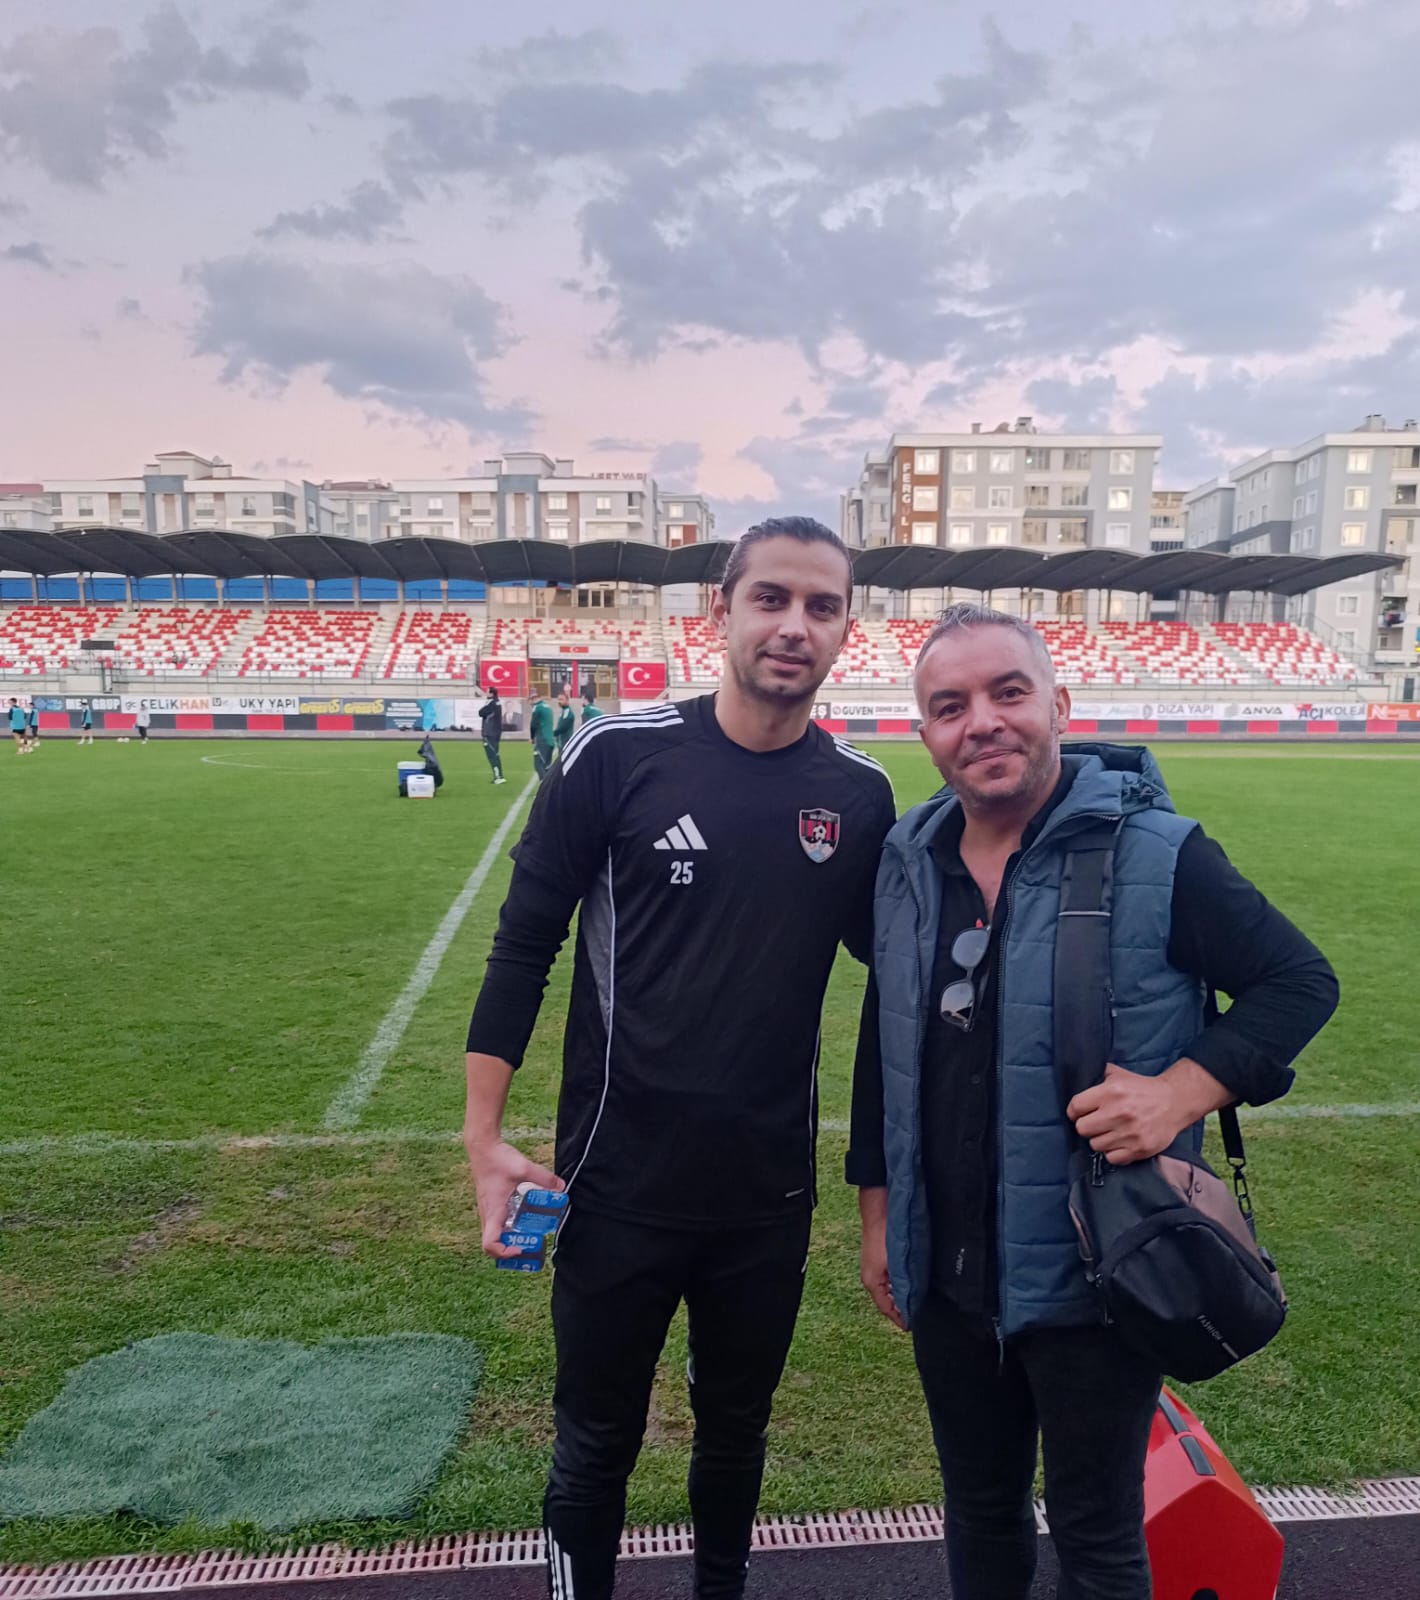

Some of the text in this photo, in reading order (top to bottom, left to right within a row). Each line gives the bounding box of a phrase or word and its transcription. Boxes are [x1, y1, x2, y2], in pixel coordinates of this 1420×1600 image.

[240, 698, 264, 709] UKY
[268, 698, 296, 709] YAPI
[670, 860, 695, 885] 25
[1197, 1314, 1223, 1341] FASHION
